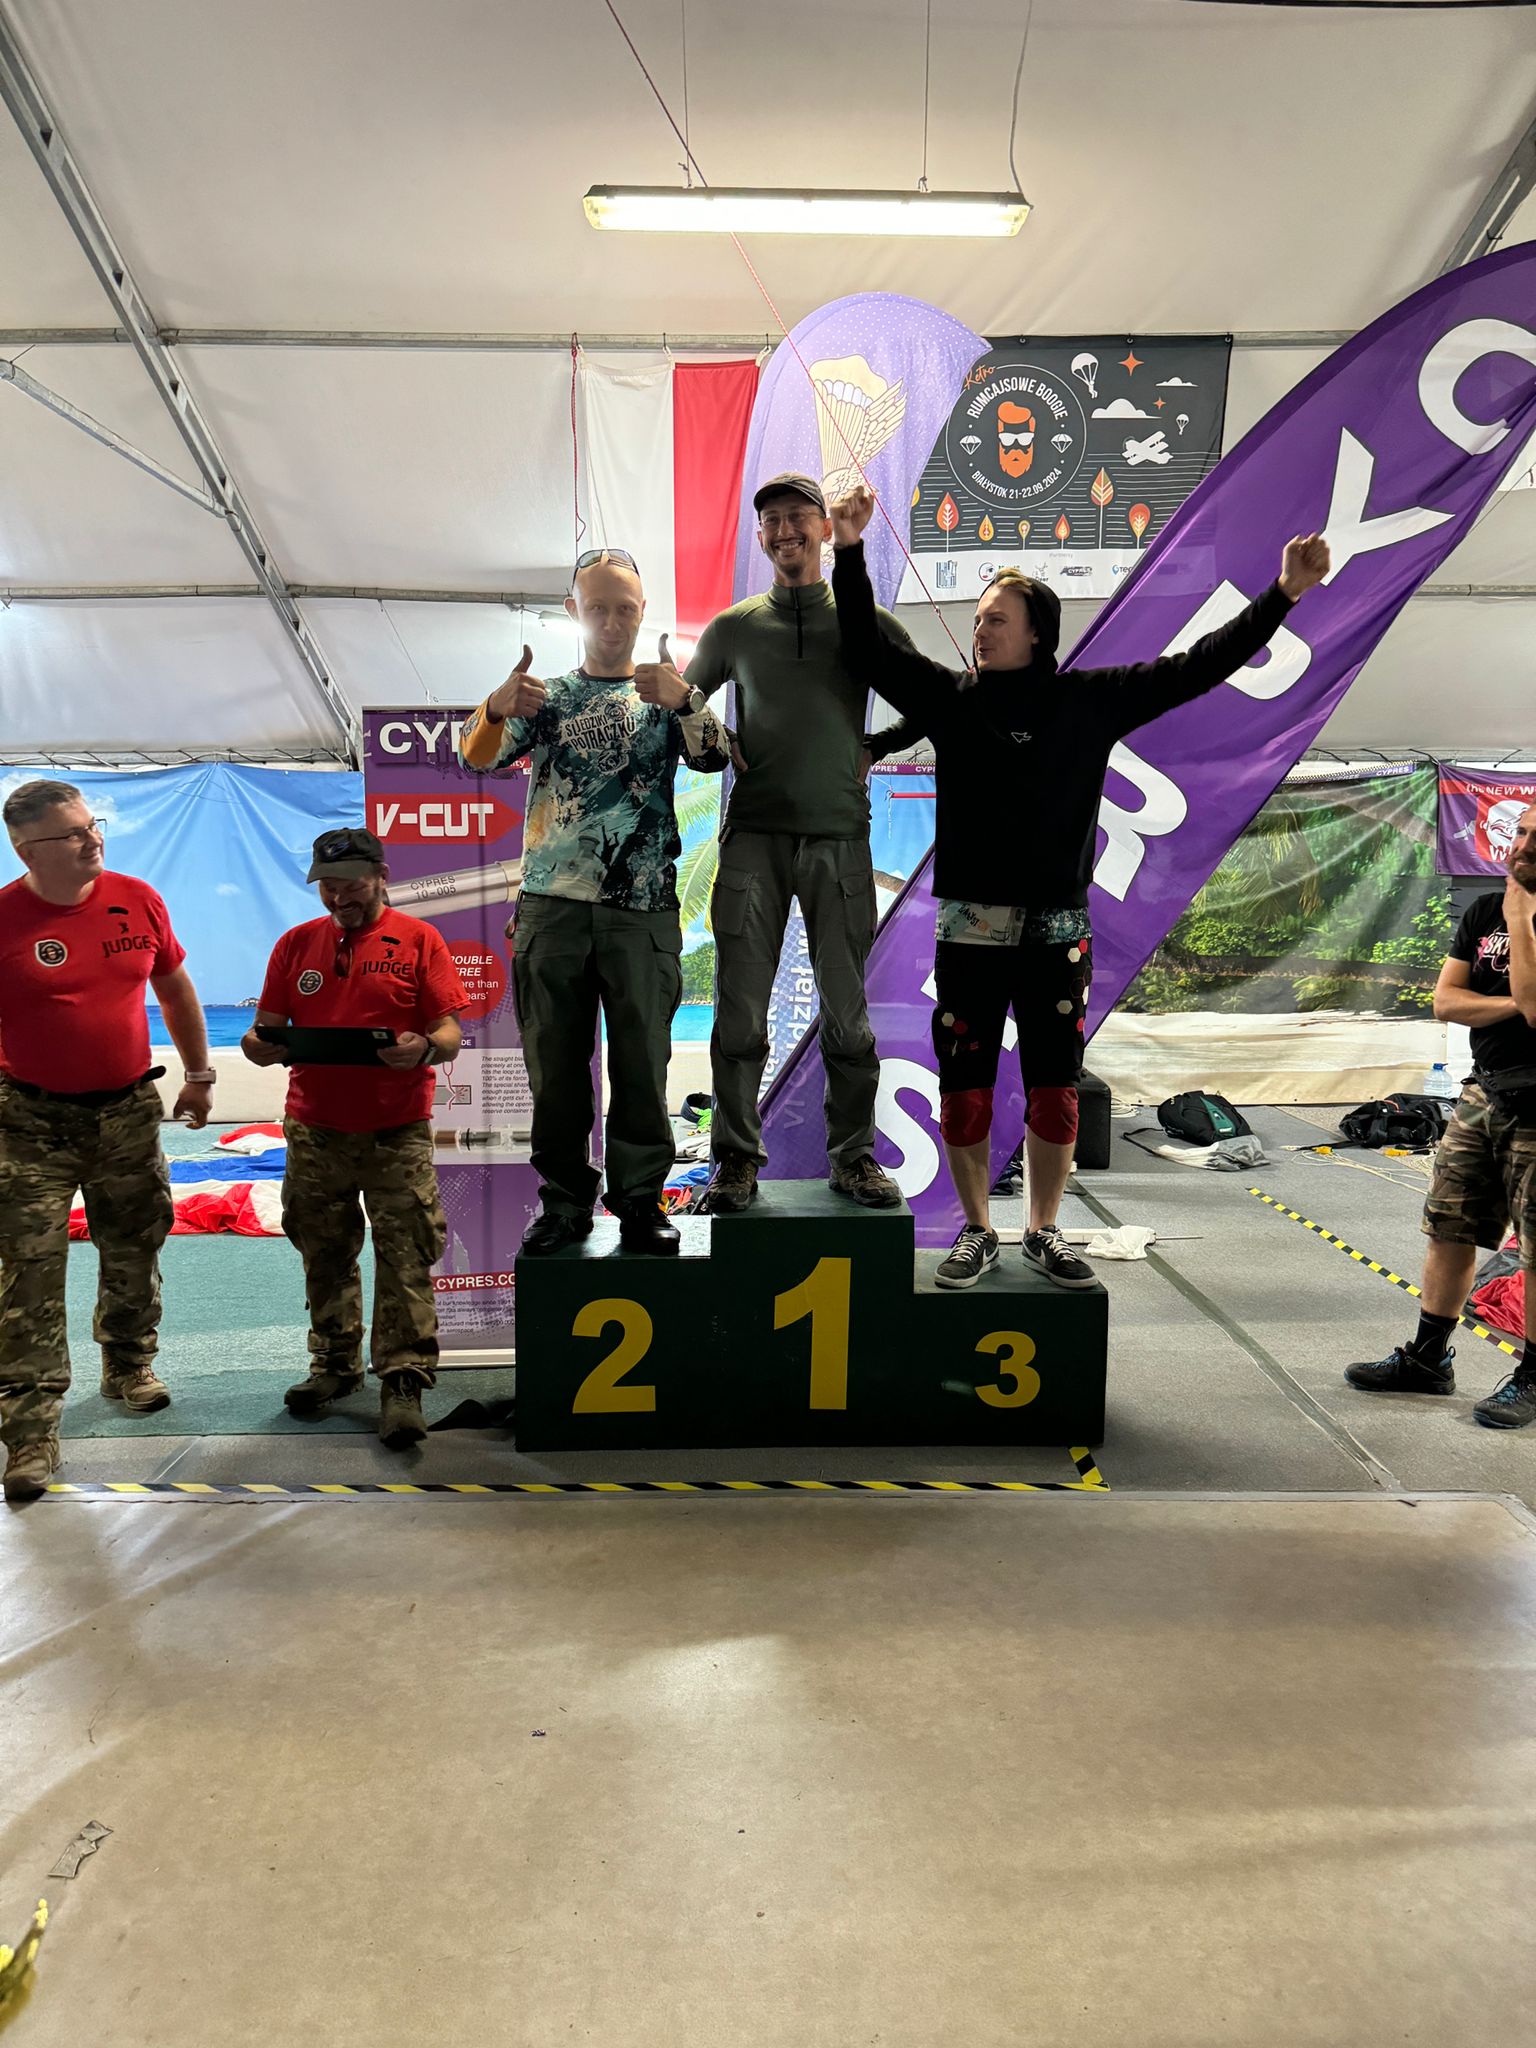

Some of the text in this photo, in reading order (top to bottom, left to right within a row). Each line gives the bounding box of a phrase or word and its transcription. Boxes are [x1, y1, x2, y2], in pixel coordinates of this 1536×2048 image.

[964, 365, 995, 390] Retro
[966, 376, 1068, 420] RUMCAJSOWE BOOGIE
[971, 467, 1062, 499] BIAŁYSTOK 21-22.09.2024
[873, 318, 1536, 1198] CYPRS
[1376, 766, 1409, 777] CYPRES
[1486, 786, 1516, 796] NEW
[1519, 786, 1536, 795] W
[376, 803, 494, 837] V-CUT
[410, 876, 456, 891] CYPRES
[415, 885, 456, 901] 10-005
[102, 935, 151, 958] JUDGE
[362, 960, 412, 976] JUDGE
[477, 980, 499, 988] than
[773, 1256, 852, 1411] 1
[571, 1297, 657, 1414] 2
[973, 1331, 1041, 1408] 3
